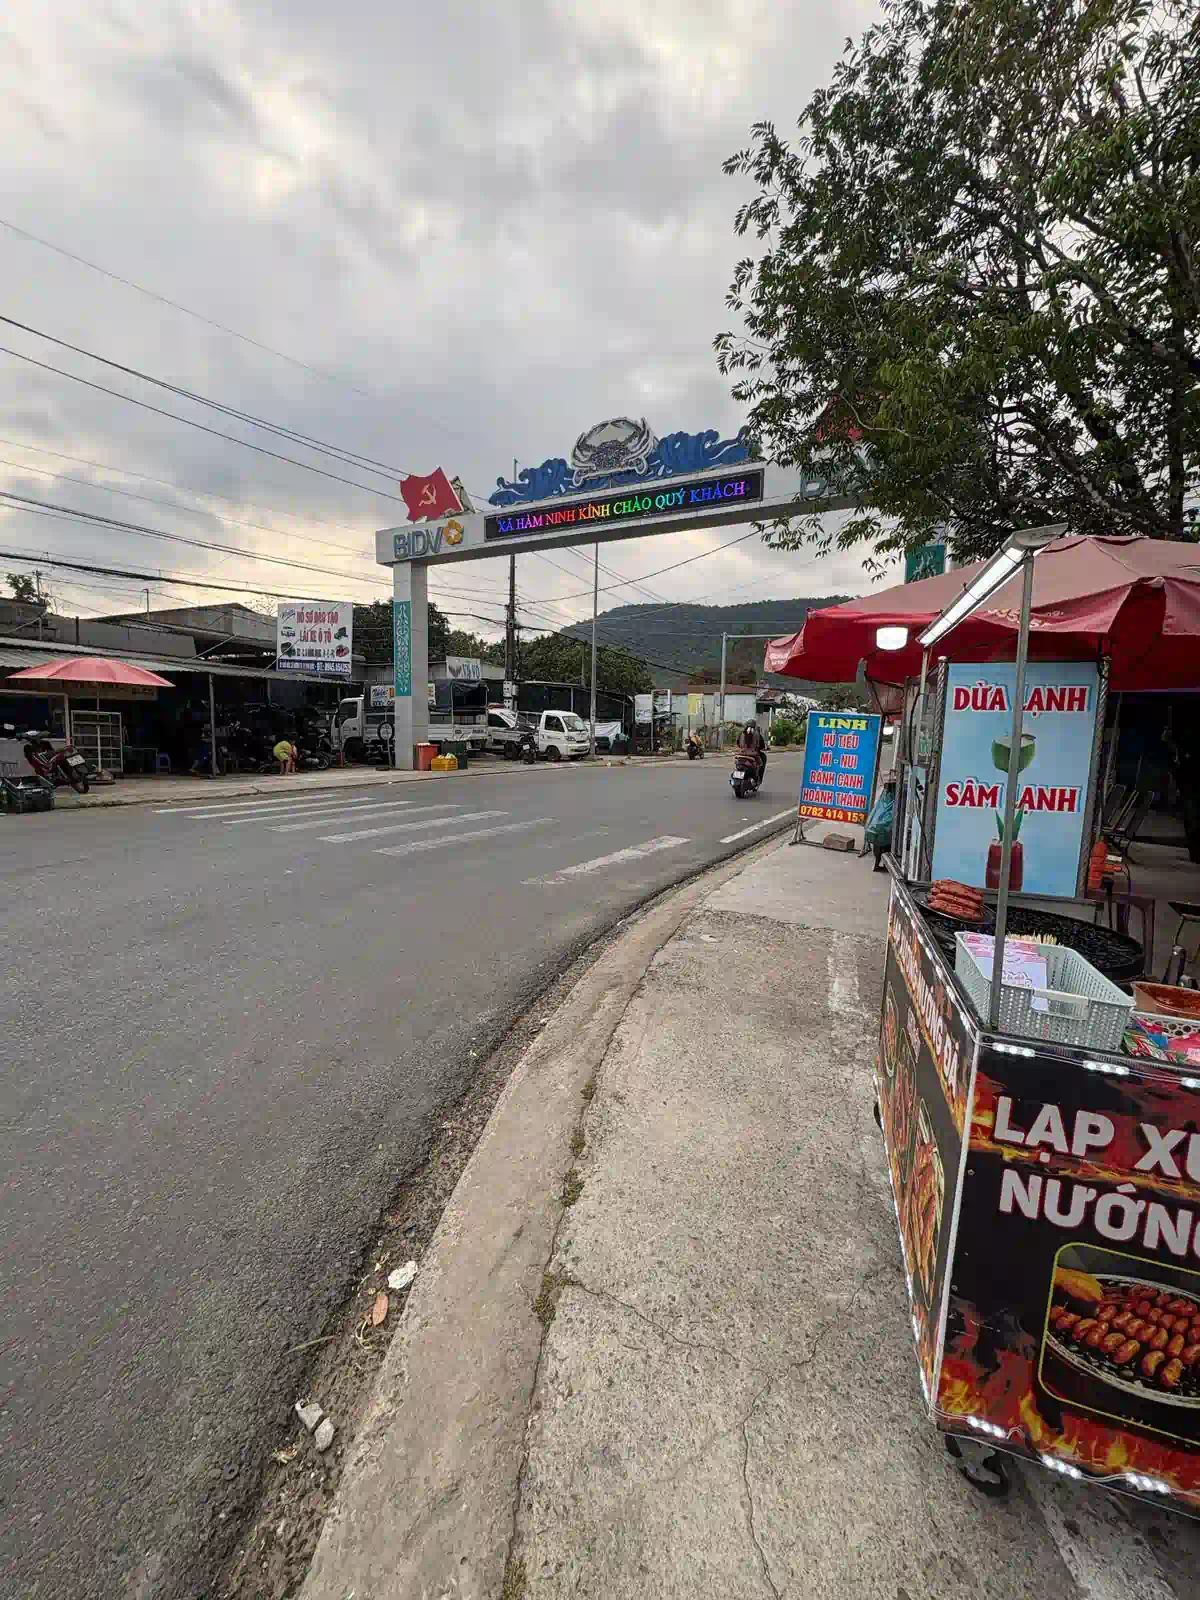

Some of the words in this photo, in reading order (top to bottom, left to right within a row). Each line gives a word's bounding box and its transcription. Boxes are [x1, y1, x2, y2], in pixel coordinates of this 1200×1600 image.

[516, 513, 544, 530] HÀM
[545, 509, 576, 525] NINH
[579, 503, 611, 520] KÍNH
[613, 495, 652, 515] CHÀO
[655, 488, 686, 508] QUÝ
[690, 481, 745, 503] KHÁCH
[393, 526, 445, 560] BIDV
[1023, 687, 1087, 717] ẠNH
[817, 717, 867, 731] LINH
[837, 773, 864, 789] CANH
[945, 779, 1000, 808] SÂM
[1016, 787, 1077, 814] ẠNH
[800, 805, 823, 817] 0782
[825, 809, 843, 820] 414
[994, 1095, 1115, 1163] LẠP
[999, 1168, 1200, 1256] NƯỚN
